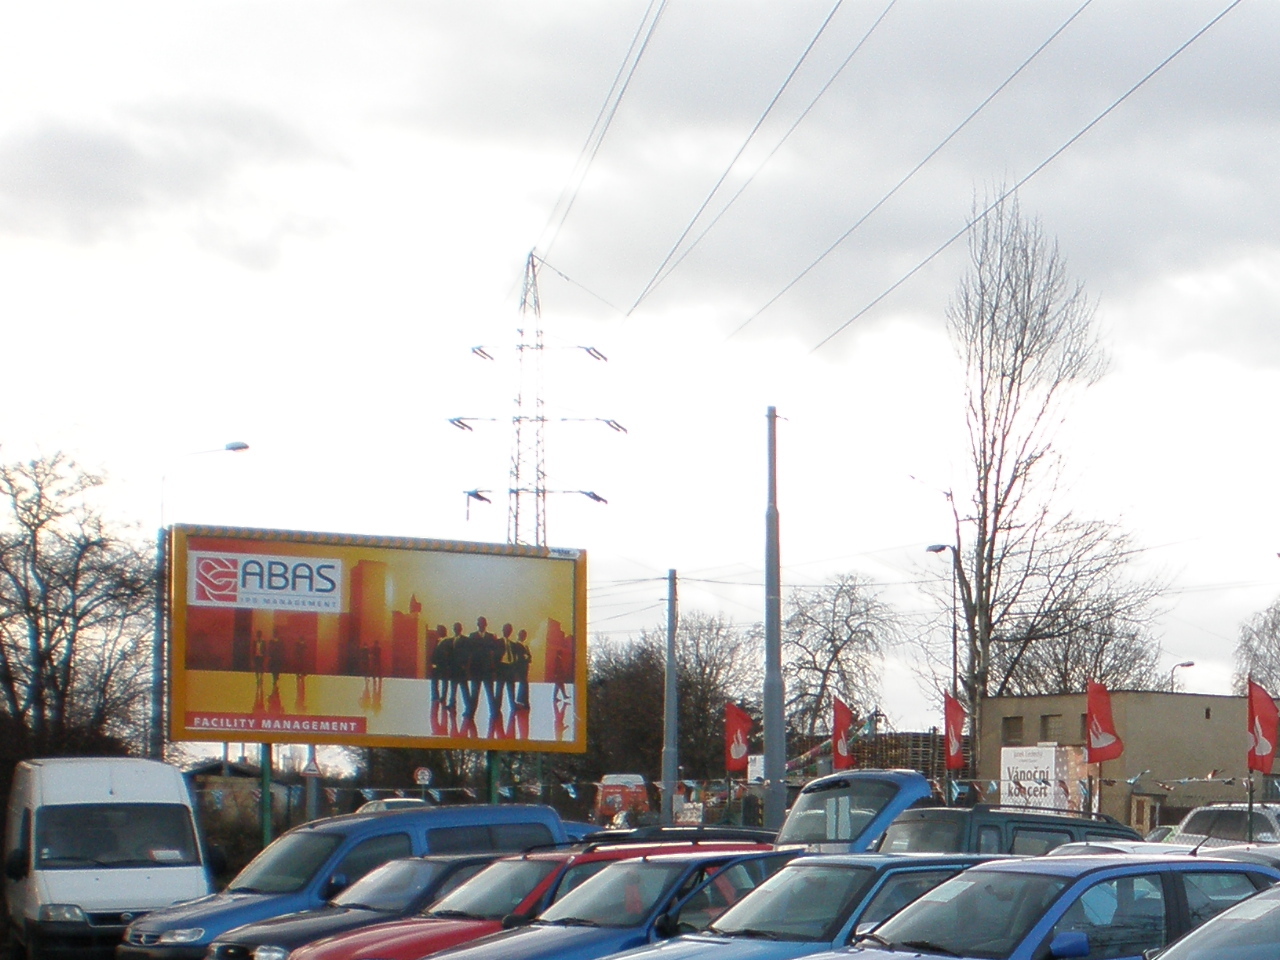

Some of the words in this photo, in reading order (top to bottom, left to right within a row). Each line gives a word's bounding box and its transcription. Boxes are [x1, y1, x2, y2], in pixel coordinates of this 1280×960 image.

[241, 559, 336, 593] ABAS
[262, 598, 337, 608] MANAGEMENT
[194, 717, 257, 729] FACILITY
[261, 719, 358, 732] MANAGEMENT
[1007, 766, 1050, 781] Vánoční
